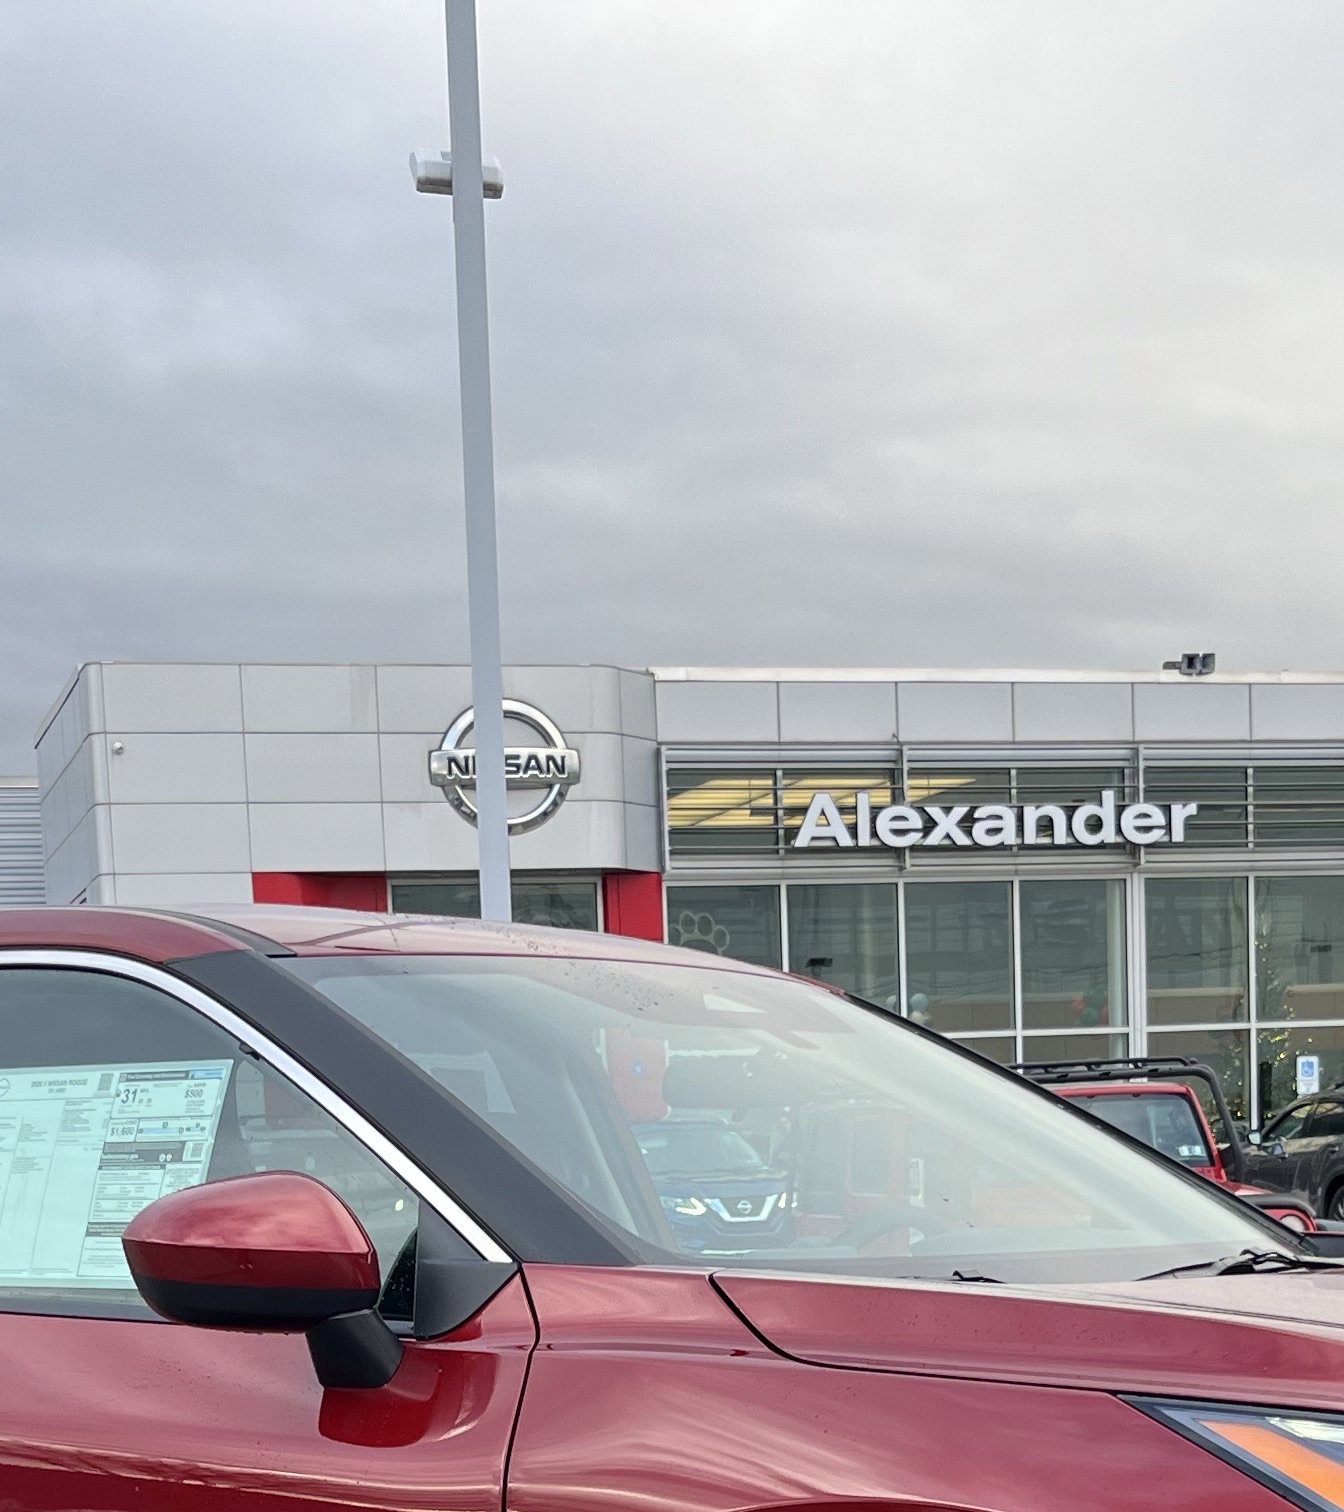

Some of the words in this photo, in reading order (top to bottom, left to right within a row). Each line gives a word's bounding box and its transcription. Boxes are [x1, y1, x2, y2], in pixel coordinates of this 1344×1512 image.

[447, 754, 567, 778] NISAN
[792, 789, 1198, 848] Alexander
[121, 1088, 138, 1104] 31
